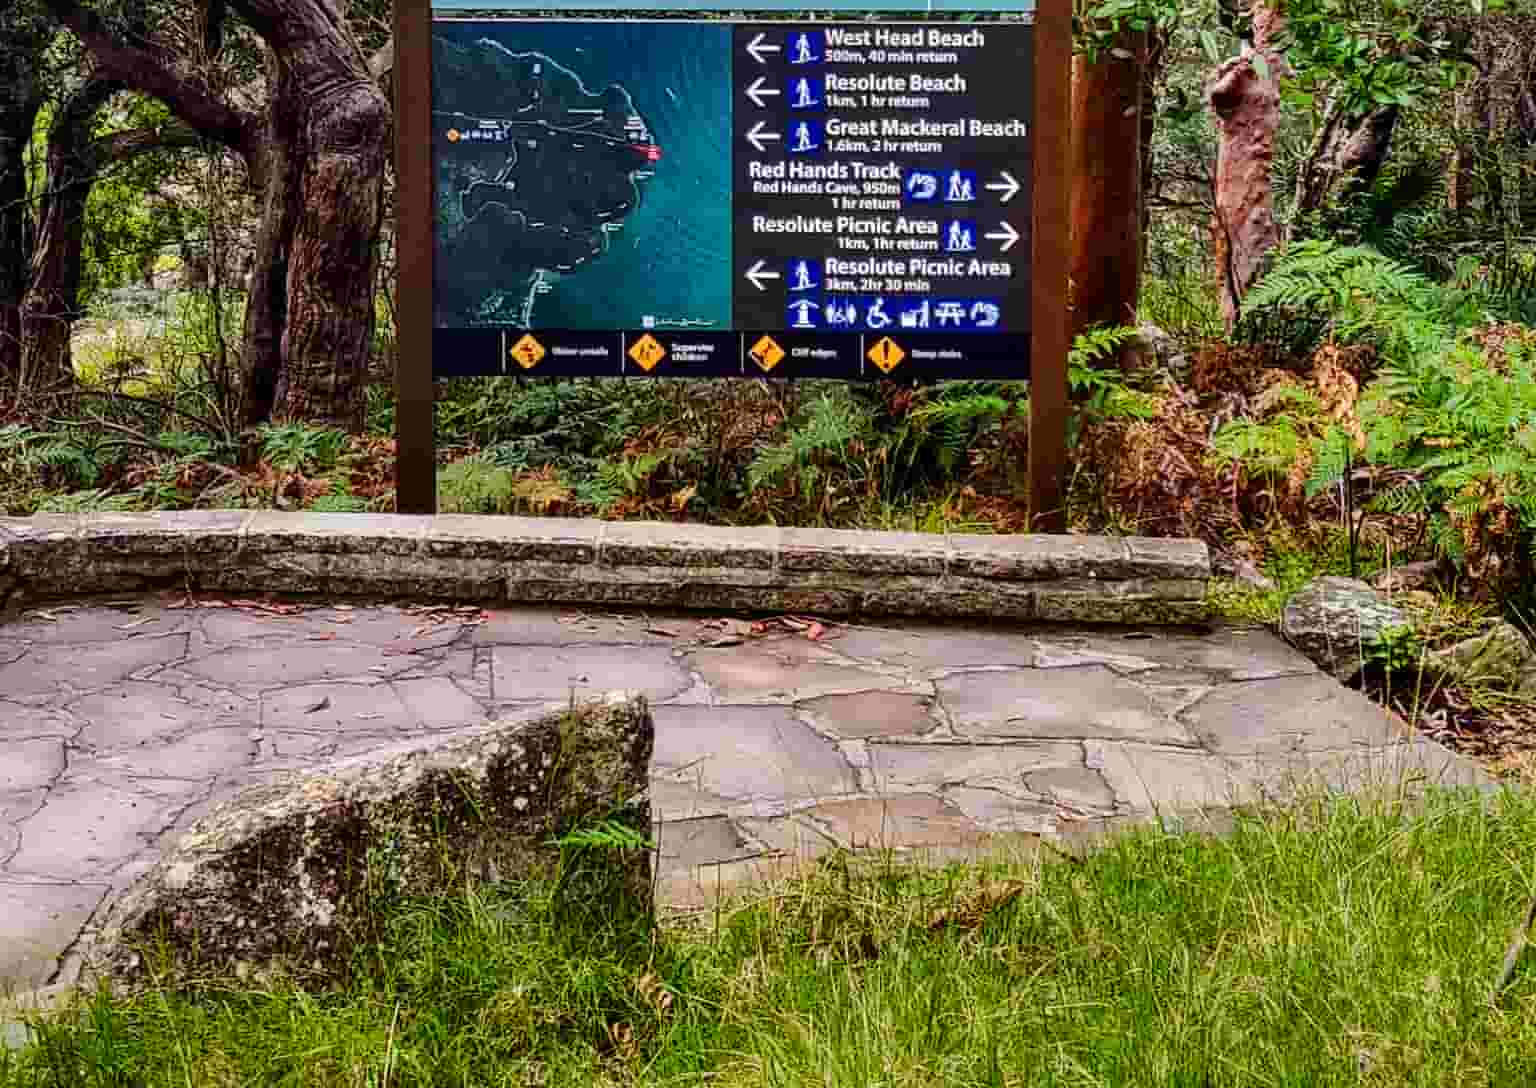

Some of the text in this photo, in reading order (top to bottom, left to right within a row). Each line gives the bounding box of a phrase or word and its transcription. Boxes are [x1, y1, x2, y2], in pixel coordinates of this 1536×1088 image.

[824, 28, 985, 48] West Head Beach
[868, 49, 886, 62] 40
[887, 49, 913, 63] min
[916, 50, 958, 63] return
[825, 72, 967, 92] Resolute Beach
[825, 94, 857, 108] 1km,
[871, 94, 886, 107] hr
[888, 95, 930, 107] return
[825, 118, 1027, 137] Great Mackeral Beach
[872, 140, 881, 152] 2
[884, 139, 899, 152] hr
[901, 140, 943, 152] return
[749, 161, 902, 179] Red Hands Track
[752, 181, 779, 193] Red
[781, 181, 823, 193] Hands
[842, 197, 858, 209] hr
[859, 198, 901, 210] return
[752, 215, 939, 234] Resolute Picnic Area
[837, 237, 870, 251] 1km,
[897, 238, 939, 250] return
[824, 258, 1012, 276] Resolute Picnic Area
[904, 278, 930, 290] min
